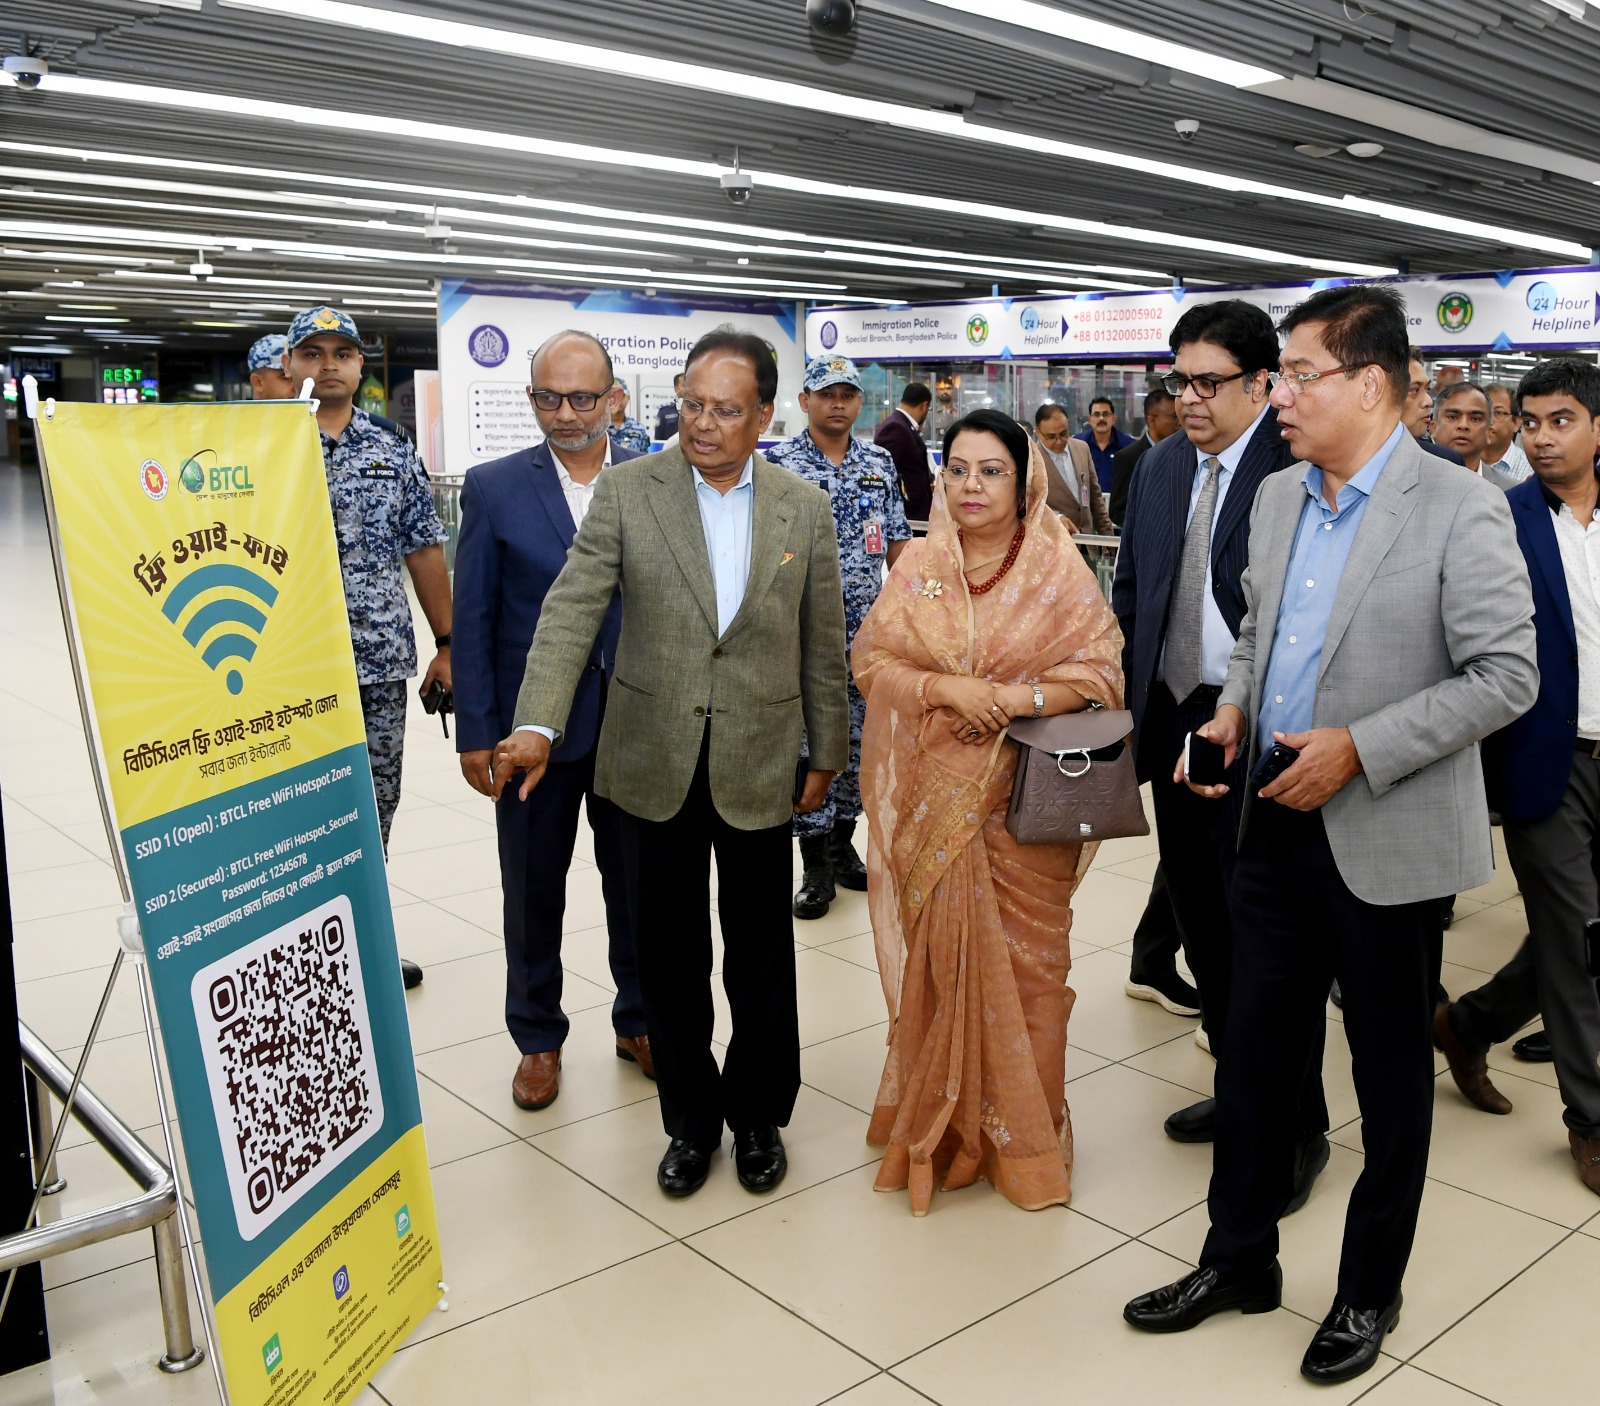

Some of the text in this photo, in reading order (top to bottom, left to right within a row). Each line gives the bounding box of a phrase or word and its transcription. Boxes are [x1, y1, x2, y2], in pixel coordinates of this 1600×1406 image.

[1533, 298, 1590, 311] 24 Hour
[1073, 308, 1162, 322] +88 01320005902
[1406, 315, 1422, 325] ice
[862, 318, 939, 333] Immigration Police
[1024, 319, 1058, 330] 24 Hour
[1532, 317, 1591, 333] Helpline
[597, 333, 696, 351] igration Polic
[846, 331, 957, 344] Special Branch, Bangladesh Police
[1024, 335, 1060, 347] Helpline
[1073, 328, 1162, 342] +88 01320005376
[628, 354, 687, 369] Banglade
[103, 368, 142, 382] REST
[209, 466, 254, 492] BTCL
[217, 491, 237, 500] মানুষের
[133, 551, 167, 597] ফ্রি
[123, 694, 339, 775] বিটিসিএল ফ্রি ওয়াই-ফাই হটস্পট জোন
[199, 735, 291, 779] সবার জন্য ইন্টারনেট
[135, 838, 162, 860] SSID
[164, 832, 171, 848] 1
[173, 814, 213, 846] (Open)
[220, 805, 248, 826] BTCL
[248, 796, 272, 815] Free
[272, 784, 294, 805] WiFi
[295, 774, 330, 797] Hotspot
[330, 765, 352, 782] Zone
[144, 896, 167, 914] SSID
[169, 890, 177, 904] 2
[177, 866, 225, 900] (Secured)
[230, 858, 254, 876] BTCL
[254, 850, 274, 865] Free
[274, 839, 294, 856] WiFi
[295, 808, 358, 848] Hotspot_Secured
[222, 852, 308, 902] Password: 12345678
[202, 908, 243, 938] সংযোগের
[243, 898, 262, 917] জন্য
[262, 886, 286, 907] নিচের
[286, 880, 299, 896] QR
[299, 864, 324, 889] কোডটি
[326, 859, 343, 876] স্ক্যান
[343, 848, 362, 867] করুন
[249, 1274, 290, 1322] বিটিসিএল
[291, 1261, 304, 1281] এর
[304, 1234, 333, 1268] অন্যান্য
[332, 1198, 371, 1240] উল্লেখযোগ্য
[371, 1170, 401, 1204] সেবাসমূহ
